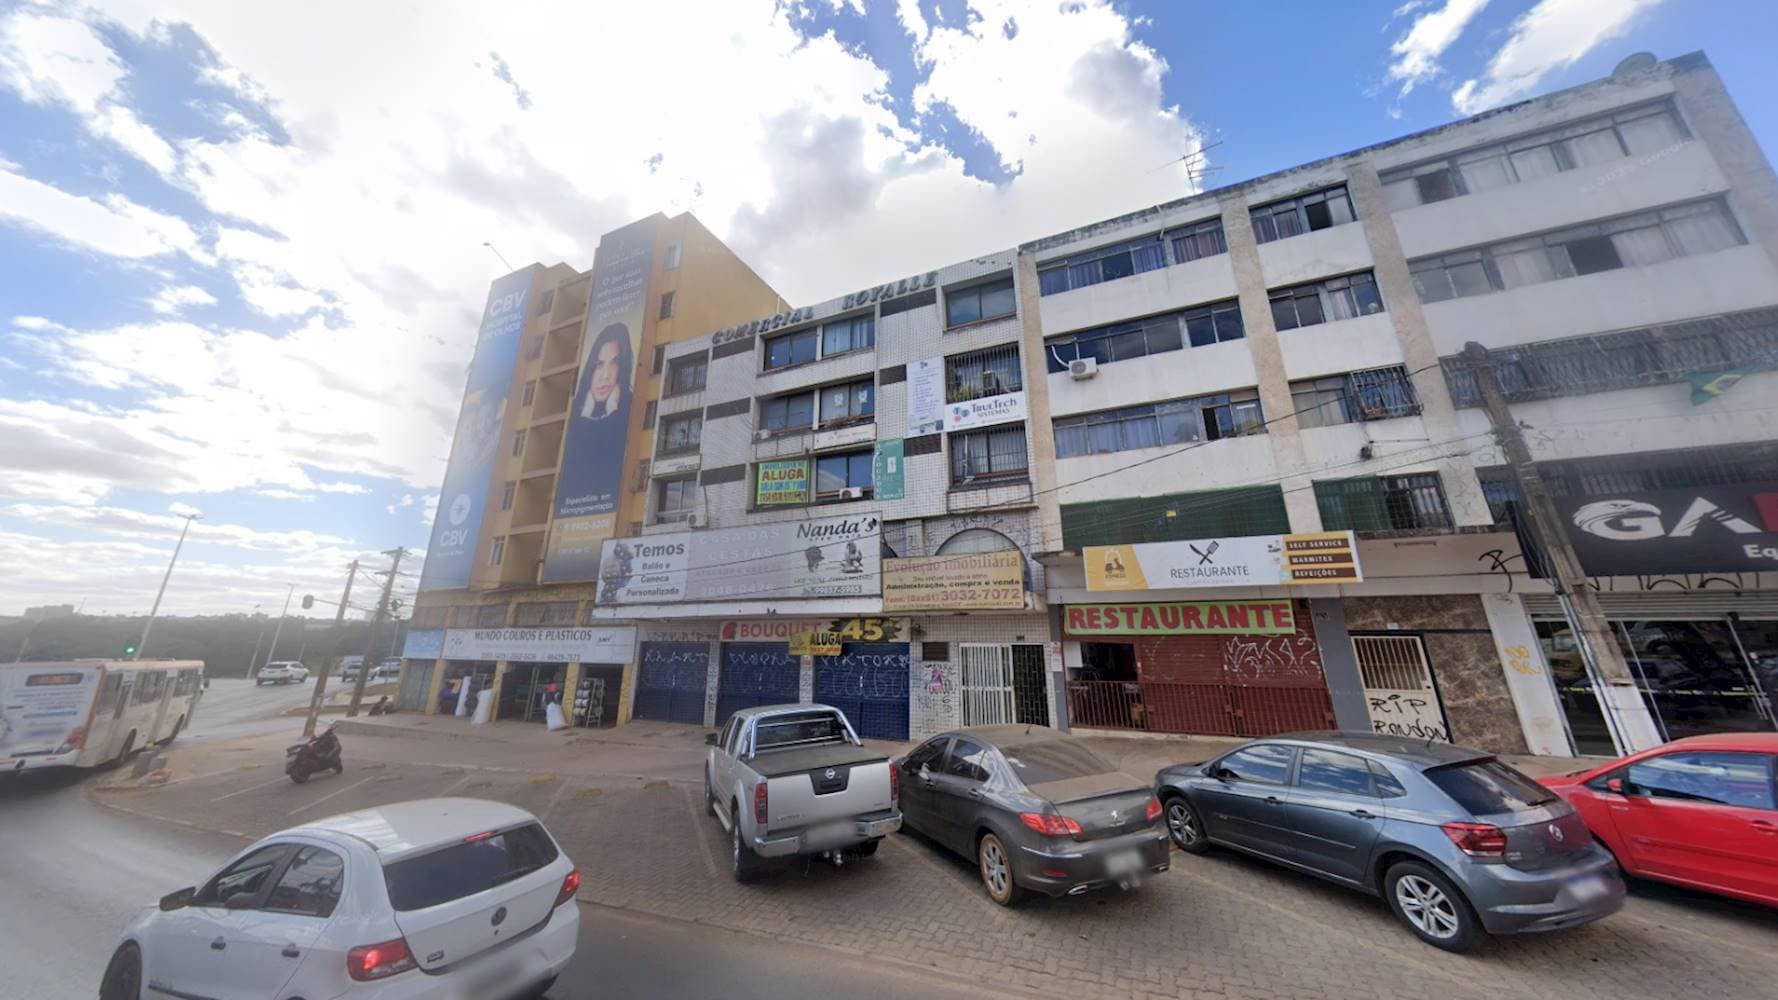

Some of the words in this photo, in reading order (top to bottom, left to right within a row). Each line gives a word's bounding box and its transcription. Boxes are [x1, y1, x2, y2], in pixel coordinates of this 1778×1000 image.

[490, 288, 528, 318] CBV
[711, 306, 815, 345] COMERCIAL
[842, 271, 939, 310] ROYALLE
[762, 468, 805, 481] ALUGA
[797, 518, 874, 539] Nanda's
[440, 528, 469, 548] CBV
[1310, 540, 1342, 548] SERVICE
[634, 543, 685, 558] Temos
[886, 560, 941, 575] Evolução
[1170, 565, 1249, 579] RESTAURANTE
[1295, 569, 1337, 577] REFEIÇÕES
[641, 575, 670, 584] Caneca
[950, 580, 982, 588] compra
[626, 587, 680, 597] Personalizada
[941, 588, 1021, 600] 3032-7072
[1068, 603, 1292, 630] RESTAURANTE
[474, 631, 503, 641] MUNDO
[504, 630, 537, 641] COUROS
[841, 619, 883, 641] 45
[810, 633, 841, 646] ALUGA
